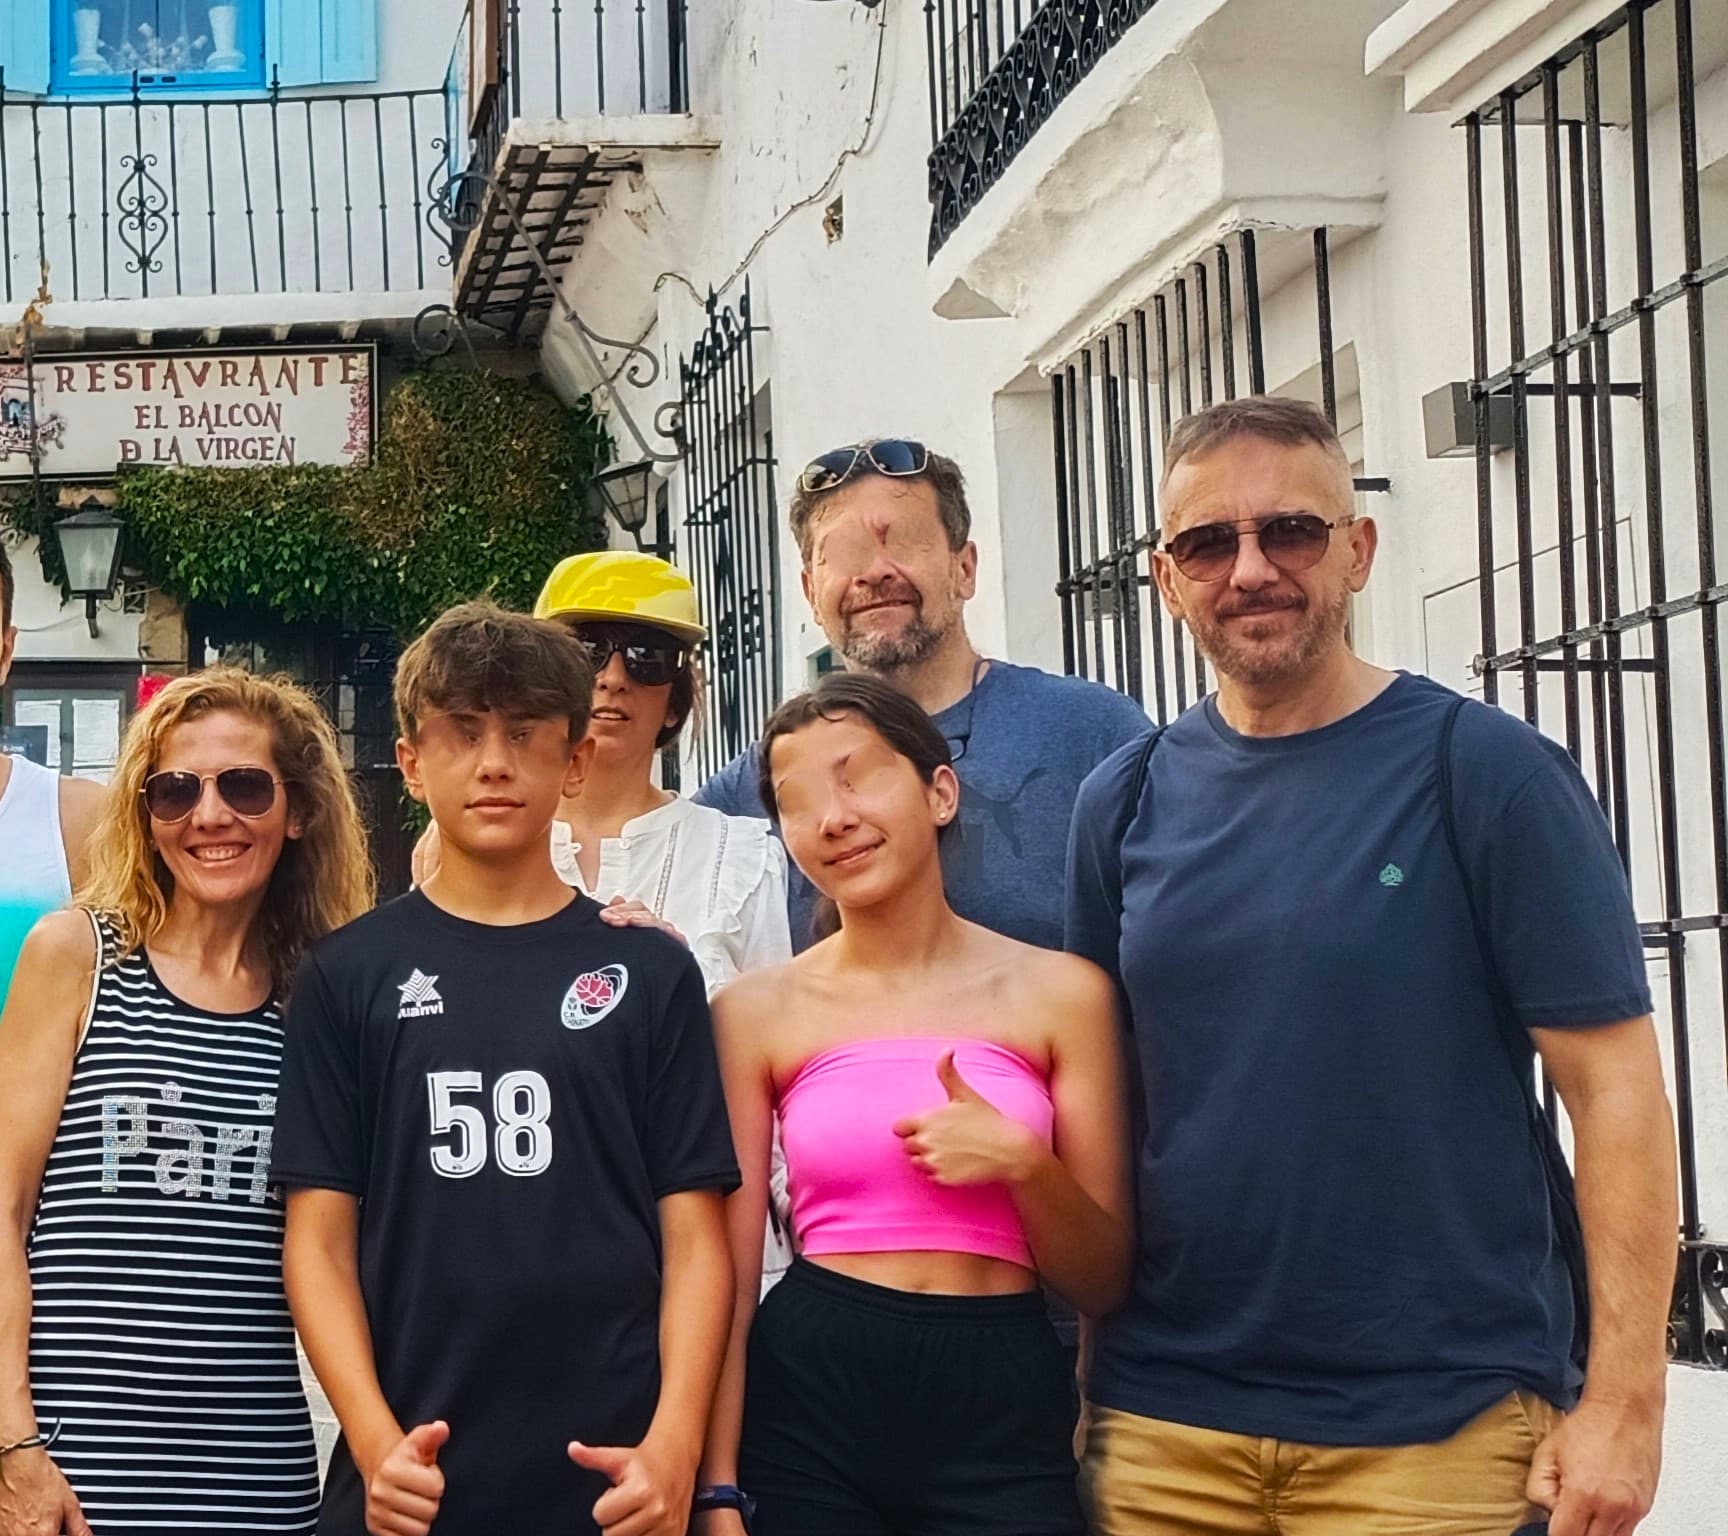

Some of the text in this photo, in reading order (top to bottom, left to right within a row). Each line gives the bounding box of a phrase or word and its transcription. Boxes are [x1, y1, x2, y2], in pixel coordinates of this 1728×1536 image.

[134, 400, 283, 436] EL BALCON
[153, 436, 183, 465] LA
[195, 436, 297, 465] VIRGEN
[426, 1069, 553, 1179] 58
